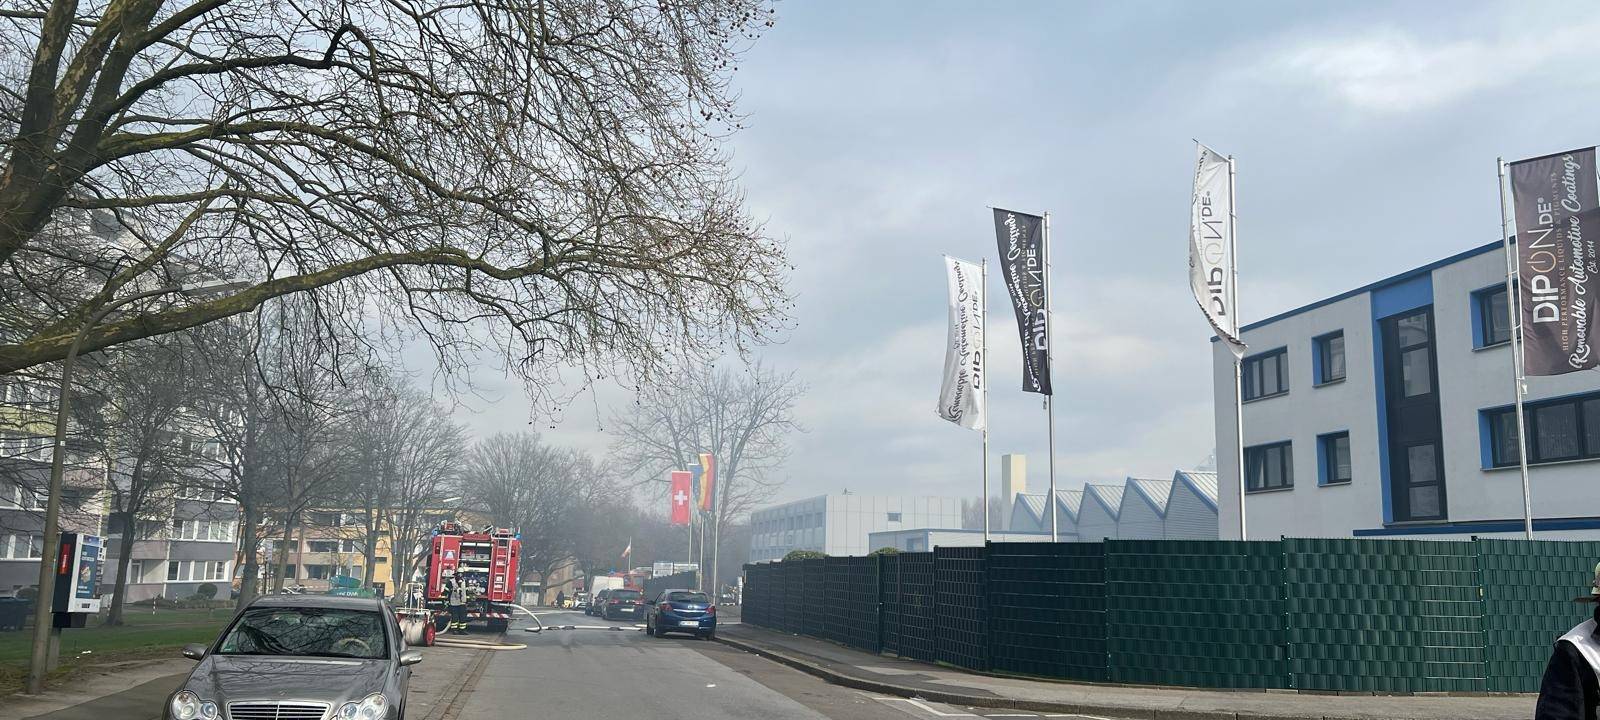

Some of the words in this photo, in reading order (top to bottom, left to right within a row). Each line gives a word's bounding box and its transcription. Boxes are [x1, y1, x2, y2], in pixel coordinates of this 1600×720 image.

[1550, 172, 1561, 216] PIGMENTS
[1560, 154, 1582, 213] Coatings
[1555, 228, 1564, 263] LIQUIDS
[1565, 215, 1589, 295] Automotive
[1586, 240, 1596, 258] 2014
[1587, 260, 1599, 274] Est.
[1558, 265, 1568, 326] PERFORMANCE
[1561, 328, 1569, 351] HIGH
[1568, 297, 1591, 368] Removable
